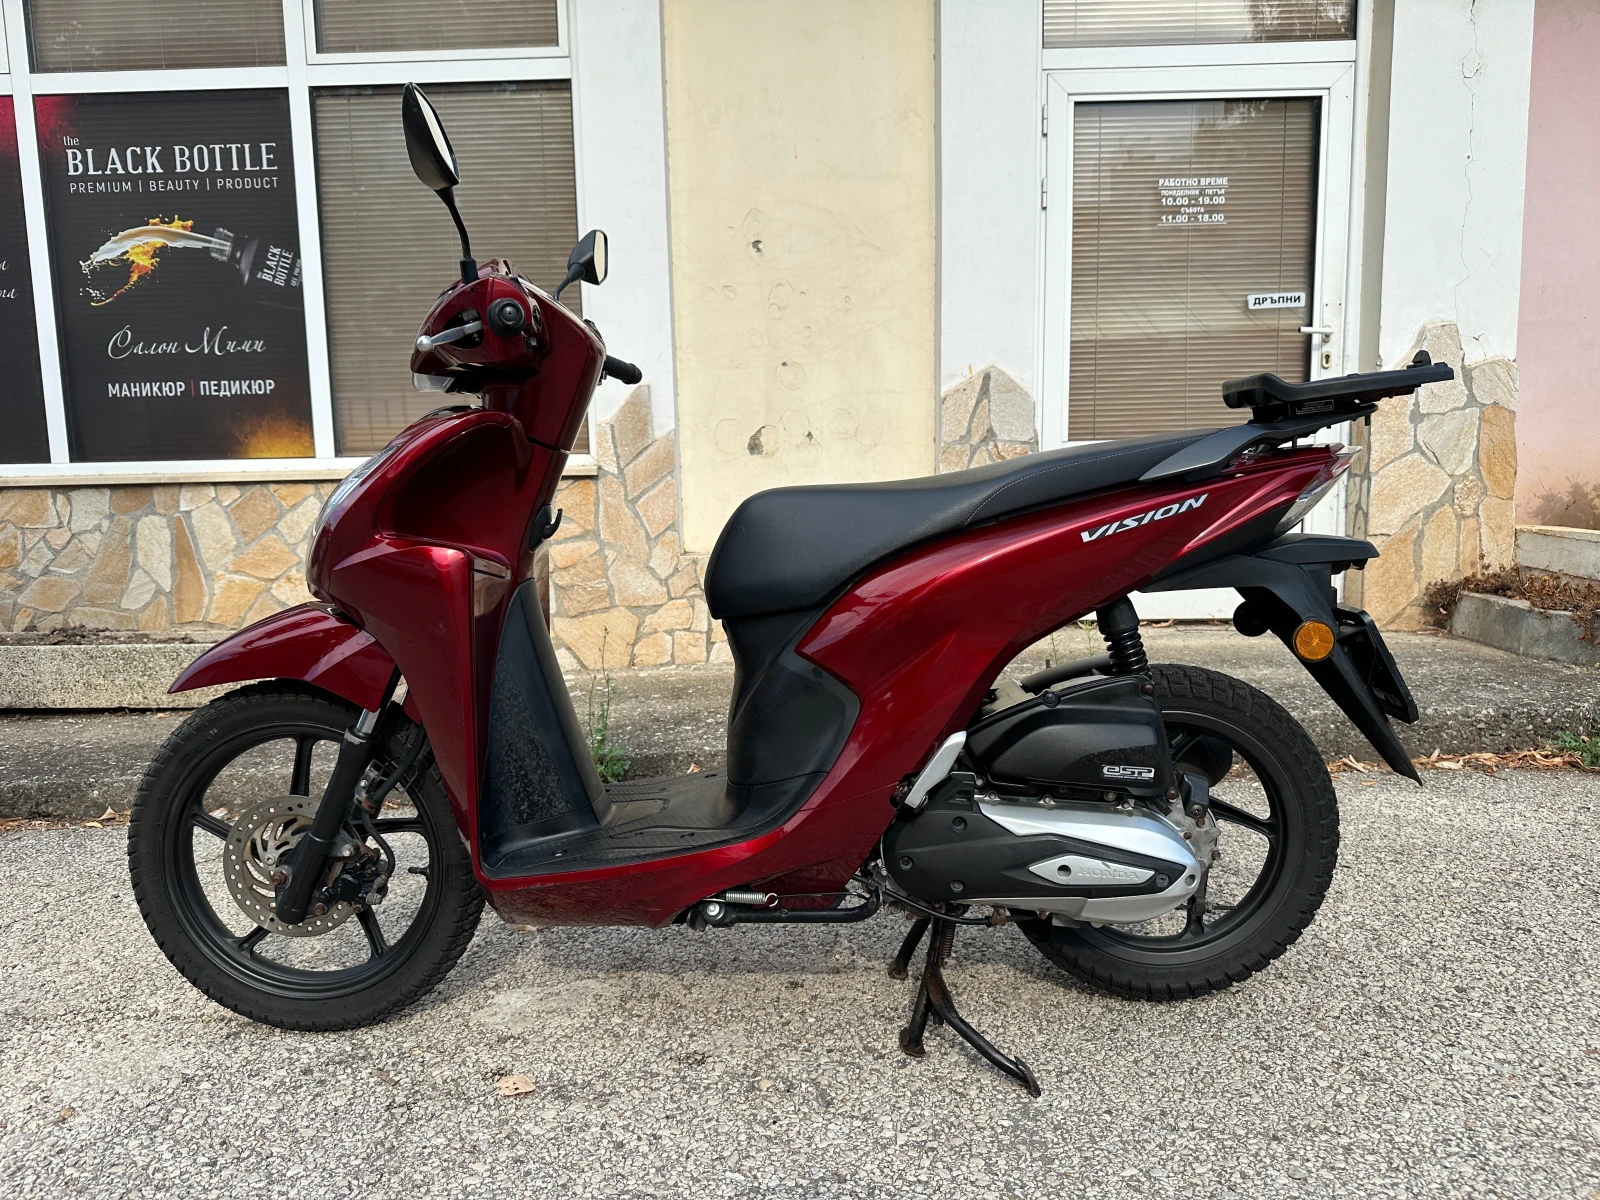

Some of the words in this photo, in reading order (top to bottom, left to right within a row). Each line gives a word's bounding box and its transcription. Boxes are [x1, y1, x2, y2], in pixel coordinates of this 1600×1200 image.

[63, 135, 80, 146] the
[66, 146, 164, 176] BLACK
[173, 142, 278, 173] BOTTLE
[70, 181, 132, 194] PREMIUM
[149, 180, 199, 192] BEAUTY
[217, 177, 278, 190] PRODUCT
[1158, 178, 1199, 187] РАБОТНО
[1200, 177, 1228, 186] ВРЕМЕ
[1161, 189, 1200, 197] ПОНЕДЕЛНИК
[1160, 197, 1189, 206] 10.00
[1197, 196, 1226, 205] 19.00
[1180, 206, 1205, 214] СЪБОТА
[1160, 214, 1189, 223] 11.00
[1197, 213, 1225, 222] 18.00
[261, 245, 281, 282] BLACK
[273, 249, 293, 287] BOTTLE
[1253, 295, 1301, 307] ДРЪПНИ
[107, 324, 182, 360] Салон
[184, 325, 267, 356] Мими
[107, 381, 186, 398] МАНИКЮР
[199, 379, 276, 398] ПЕДИКЮР
[1080, 493, 1209, 543] VISION
[1077, 867, 1140, 881] HONDA
